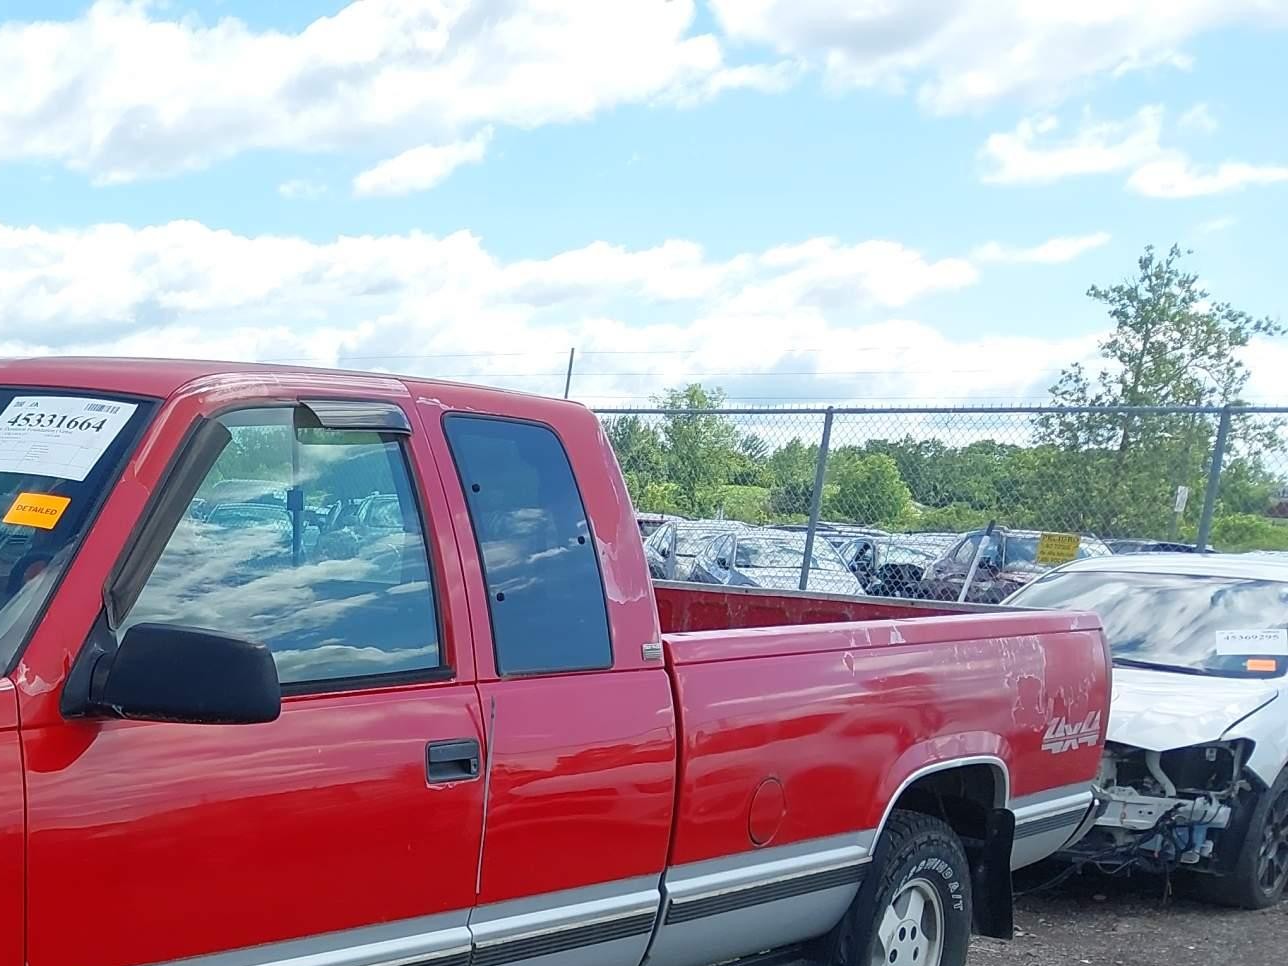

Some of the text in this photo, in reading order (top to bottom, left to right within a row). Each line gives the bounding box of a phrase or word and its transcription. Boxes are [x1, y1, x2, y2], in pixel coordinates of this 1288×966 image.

[8, 412, 107, 433] 45331664
[16, 504, 57, 516] DETAILED
[1041, 709, 1101, 754] 4x4
